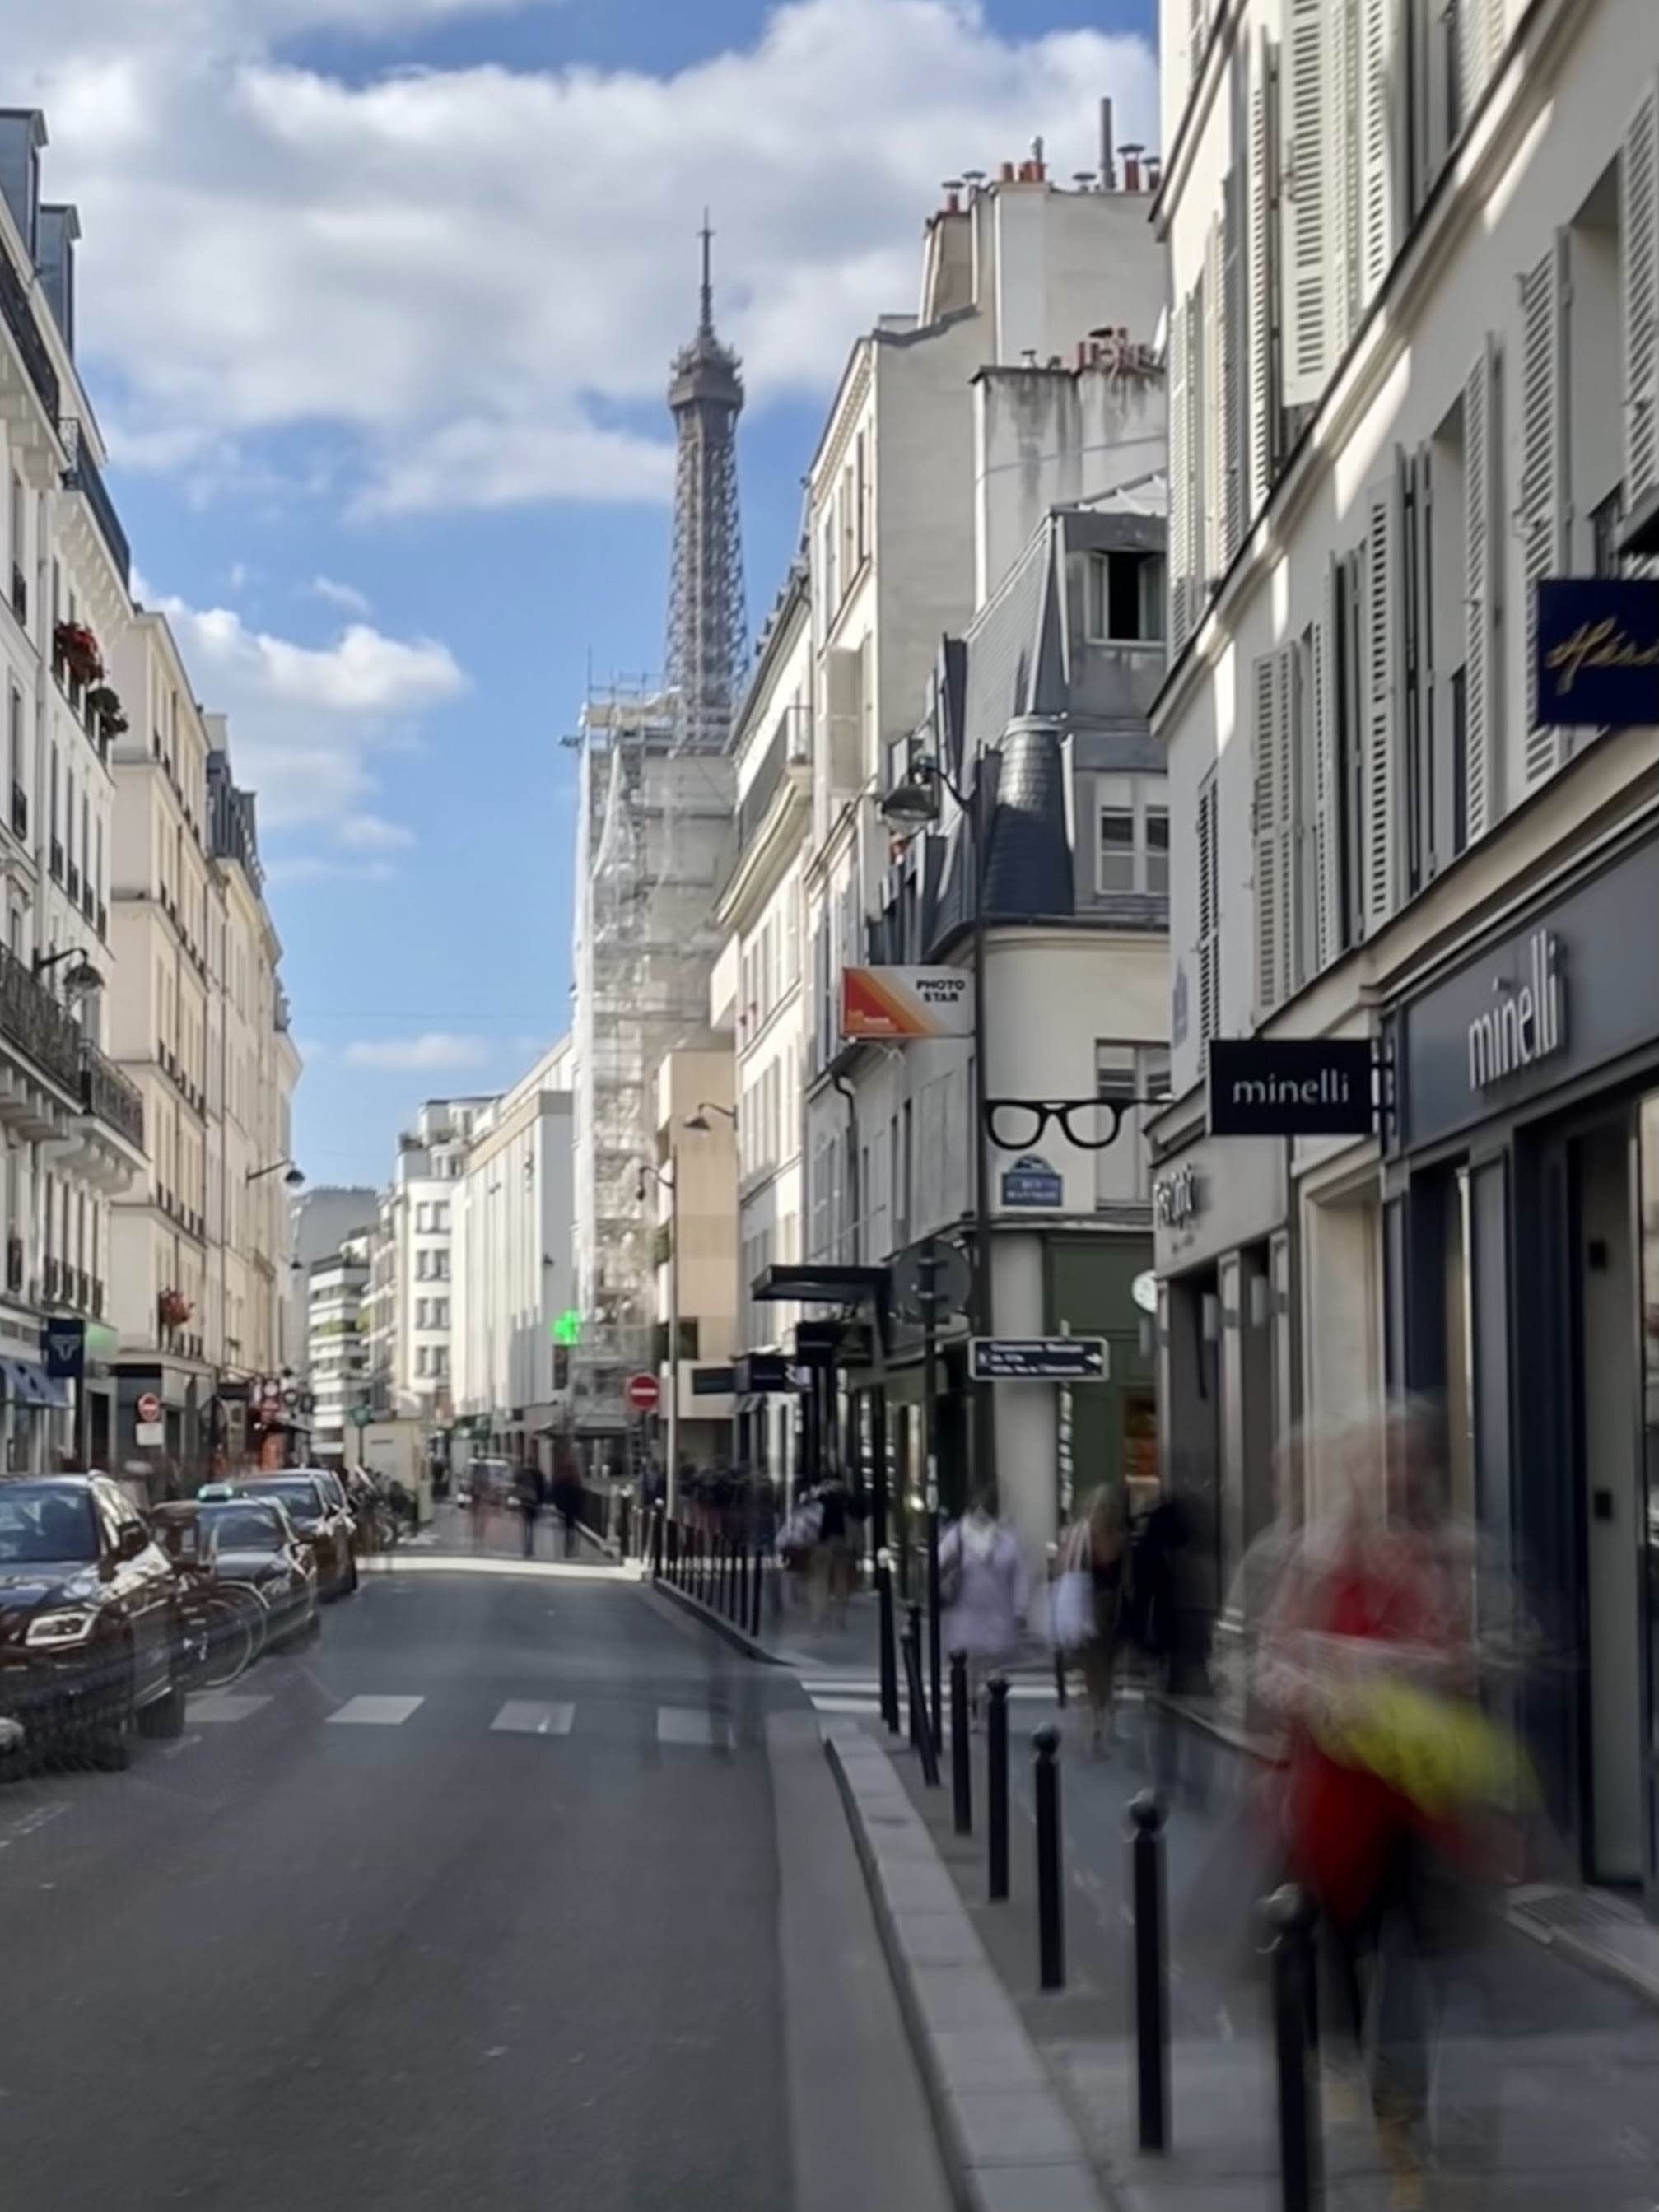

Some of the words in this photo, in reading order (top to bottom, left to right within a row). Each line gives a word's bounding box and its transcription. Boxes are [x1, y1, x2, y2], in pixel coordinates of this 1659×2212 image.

[916, 980, 965, 990] PHOTO
[924, 992, 958, 1002] STAR
[1469, 929, 1557, 1091] minelli
[1233, 1069, 1349, 1103] minelli
